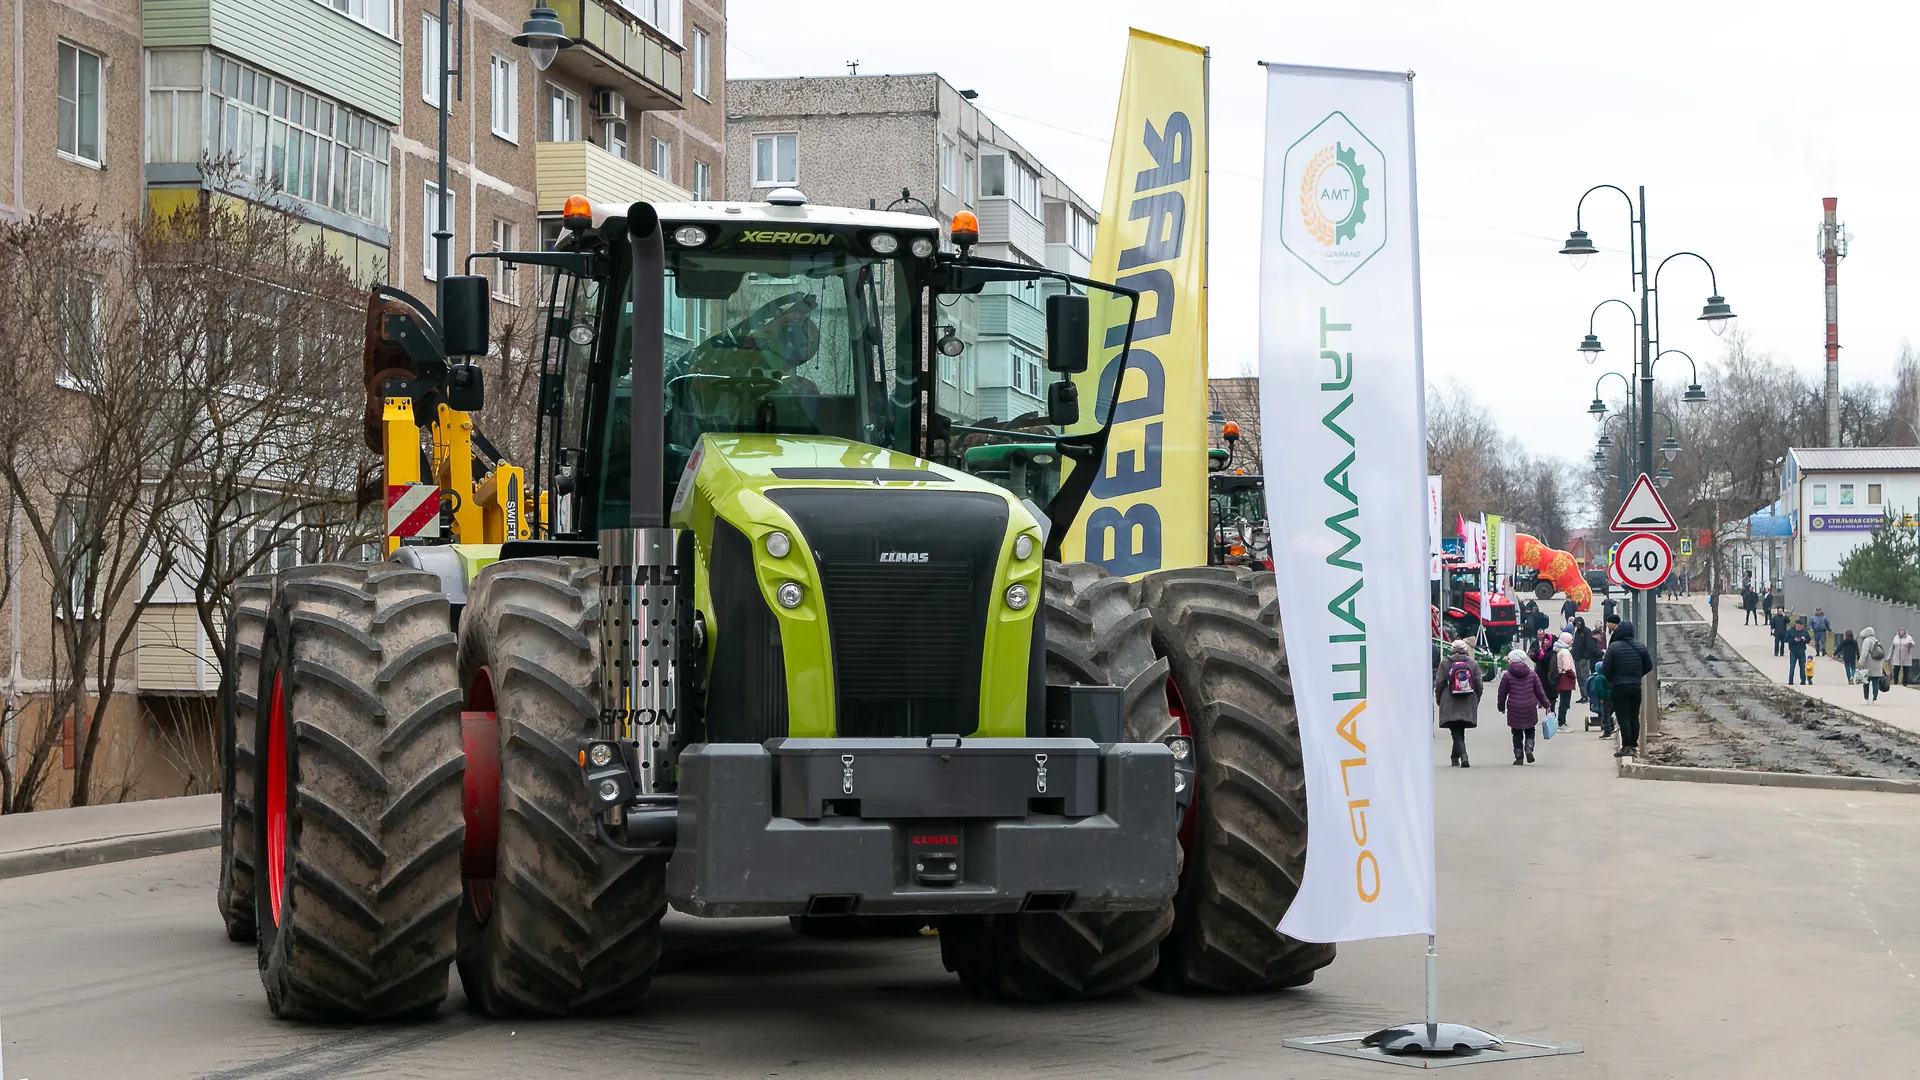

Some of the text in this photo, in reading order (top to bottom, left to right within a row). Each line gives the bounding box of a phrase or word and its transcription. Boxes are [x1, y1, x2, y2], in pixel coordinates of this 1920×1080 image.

[740, 231, 834, 245] XERION
[506, 501, 516, 540] SWIFTE
[880, 553, 929, 562] CLAAS
[1628, 551, 1658, 571] 40
[600, 565, 681, 586] LAAS
[599, 708, 677, 726] ERION
[913, 835, 958, 845] CLAAS
